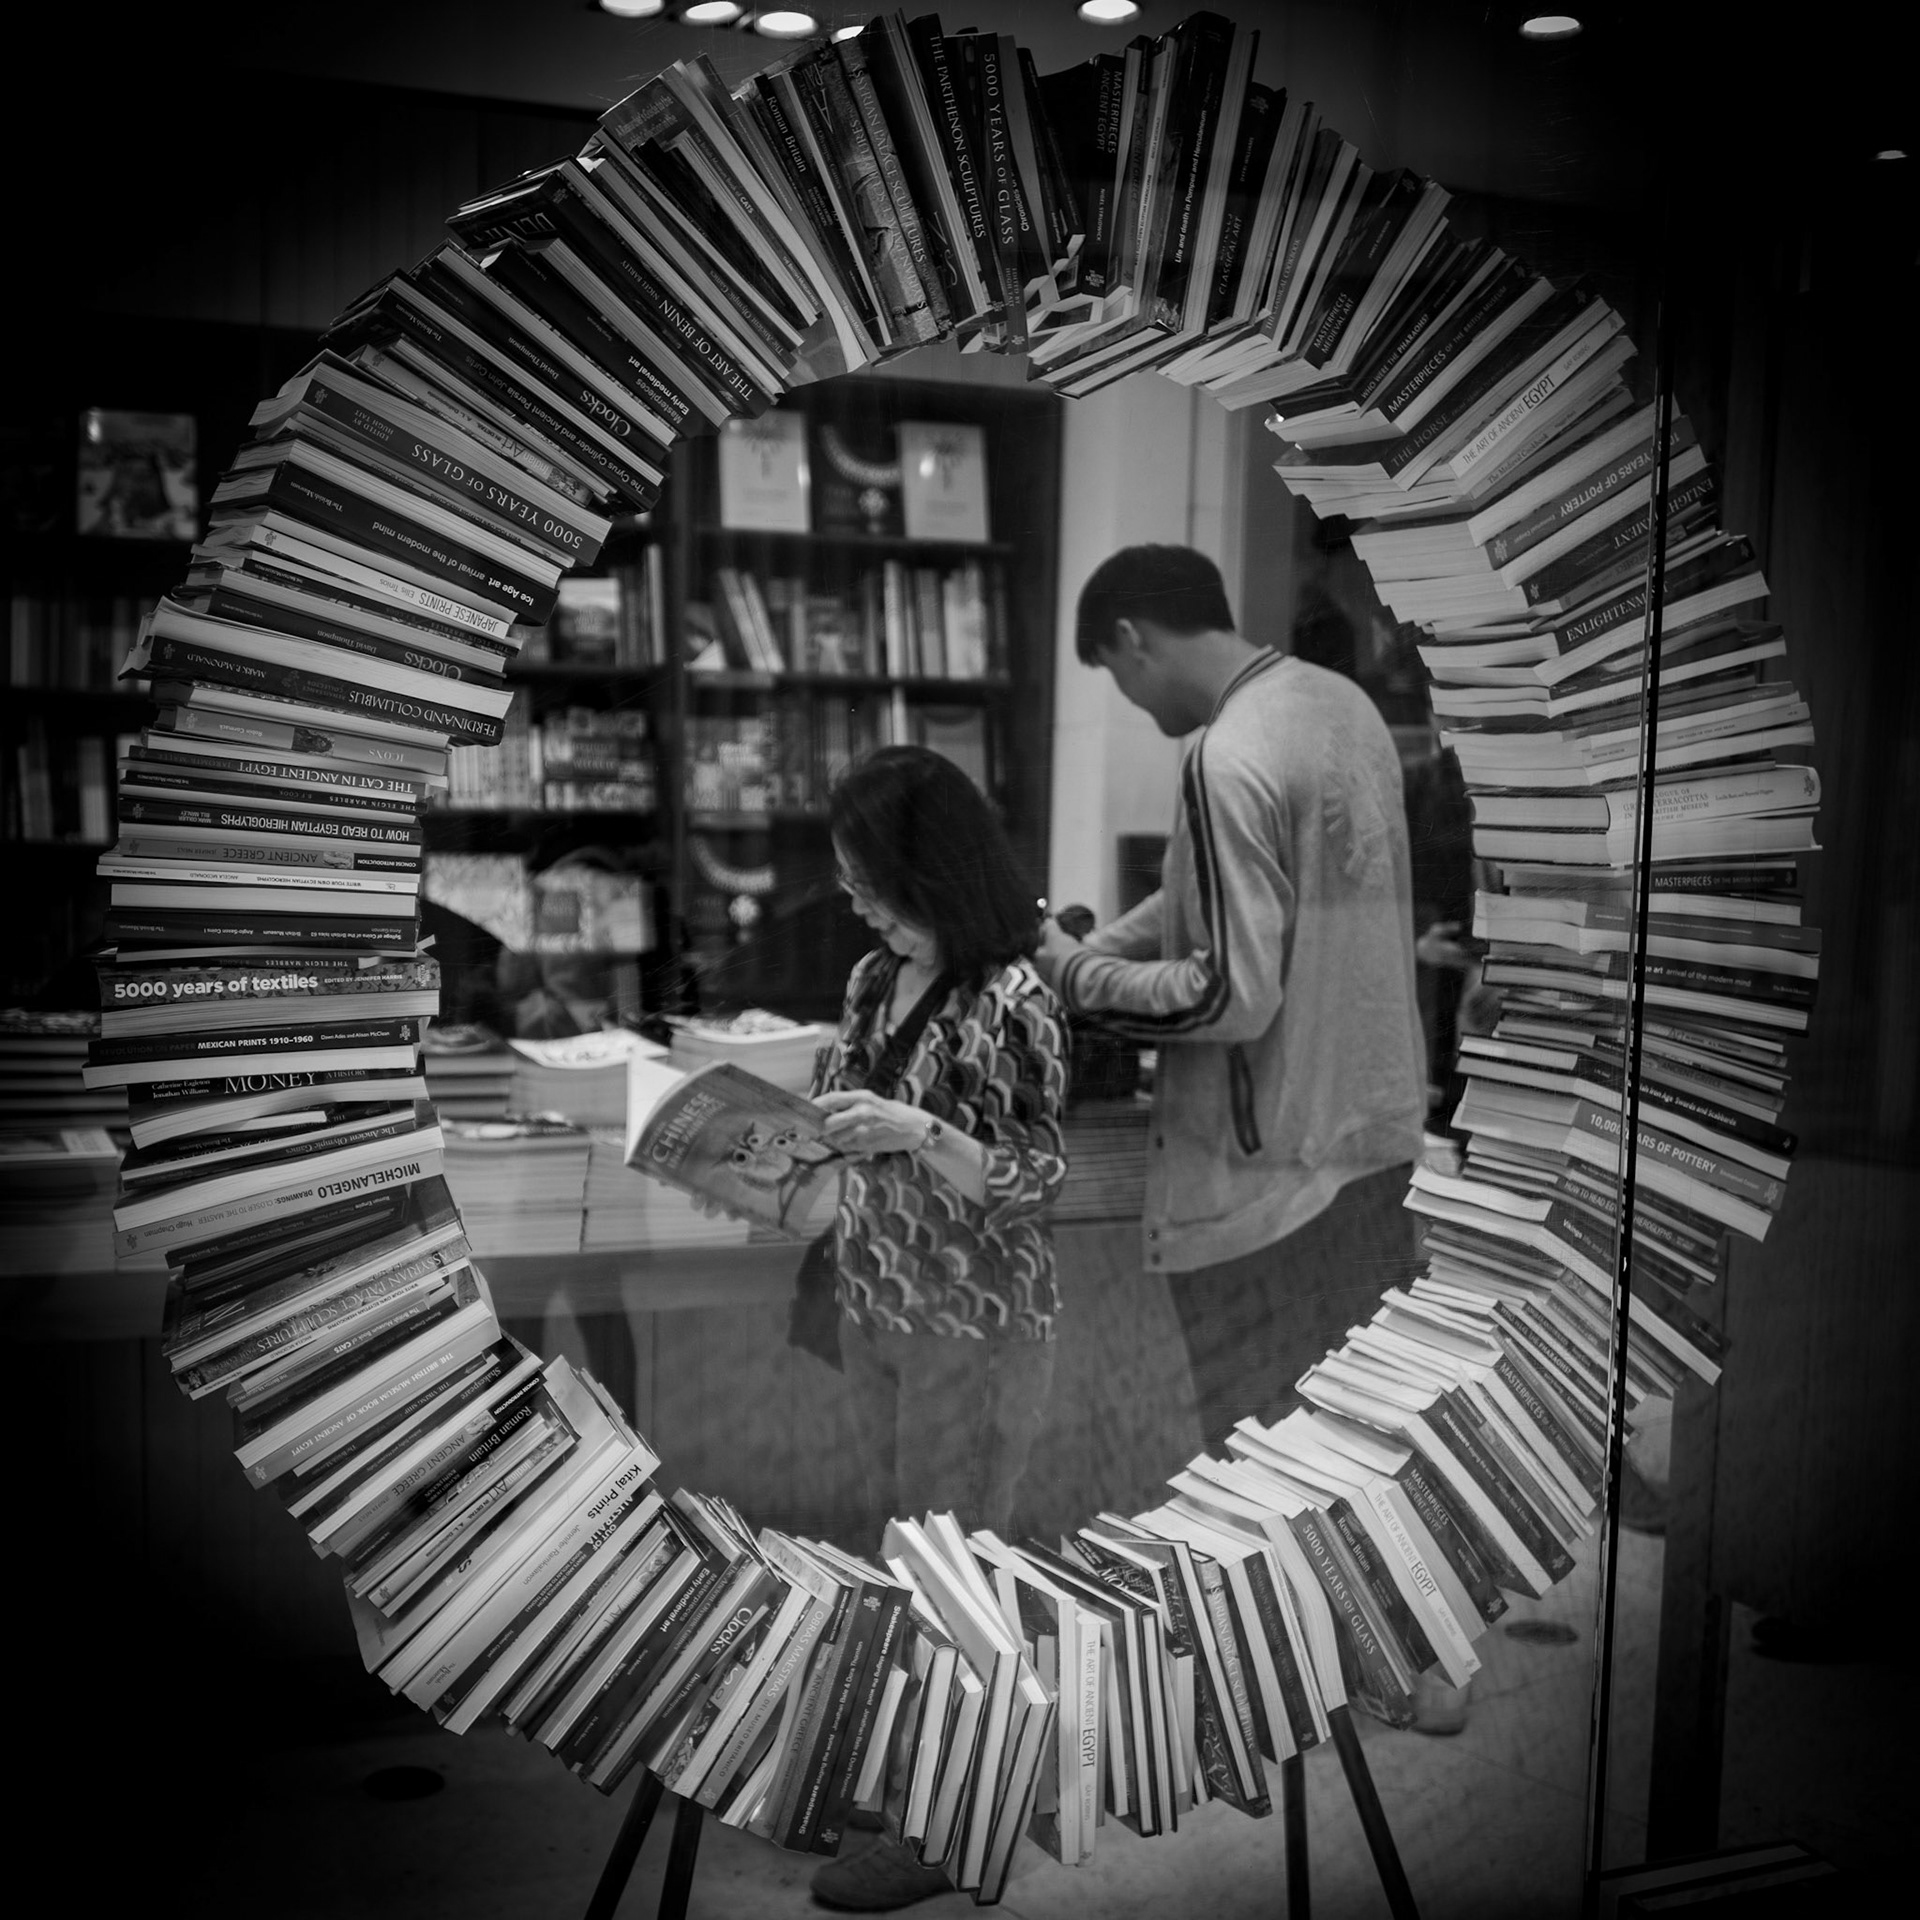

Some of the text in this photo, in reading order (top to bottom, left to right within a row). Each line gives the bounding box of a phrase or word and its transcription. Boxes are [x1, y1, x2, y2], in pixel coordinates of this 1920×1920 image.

[765, 95, 809, 173] Roman Britain
[928, 34, 987, 239] THE PARTHENON SCULPTURES
[1094, 68, 1111, 151] ANCIENT EGYPT
[1105, 70, 1124, 154] MASTERPIECES
[848, 60, 928, 264] ASSYRIAN PALACE SCULPTURES
[982, 52, 1014, 245] 5000 YEARS OF GLASS
[738, 195, 755, 214] CATS
[1174, 108, 1208, 263] Life and death in Pompeii and Herculaneum
[1216, 215, 1243, 296] CLASSICAL ART
[657, 297, 697, 339] BENIN
[691, 333, 714, 356] OF
[1312, 290, 1349, 349] MASTERPIECES
[1319, 296, 1356, 355] MEDIEVAL ART
[706, 349, 734, 378] ART
[1359, 311, 1431, 399] WHO WERE THE PHARAOHS?
[1385, 348, 1449, 414] MASTERPIECES
[574, 387, 634, 440] Clocks
[626, 354, 691, 415] Early medieval art
[633, 374, 684, 426] Masterpieces
[726, 370, 756, 401] THE
[462, 354, 647, 495] The Cyrus Cylinder and Ancient Persia John Curtis
[1461, 373, 1558, 465] THE ART OF ANCIENT EGYPT
[409, 441, 583, 550] 5000 YEARS OF GLASS
[1555, 450, 1651, 518] YEARS OF POTTERY
[1609, 476, 1716, 550] ENLIGHMENT
[370, 520, 535, 606] Ice Age art arrival of the modern mind
[377, 577, 499, 633] JAPANESE PRINTS Ellis Tinios
[1563, 579, 1672, 643] ENLIGHTENMT
[315, 627, 464, 682] Clocks David Thompson
[347, 688, 497, 737] FERDINAND COLUMBUS
[218, 722, 404, 762] ICONS Robin Cormack
[236, 760, 413, 793] THE CAT IN ANCIENT EGYPT
[219, 812, 409, 841] HOW TO READ EGYPTIAN HIEROGLYPHS
[222, 846, 416, 868] CONCISE INTRODUCTION ANCIENT GREECE
[1654, 875, 1712, 887] MASTERPIECES
[113, 981, 167, 999] 5000
[171, 981, 224, 998] years
[227, 976, 248, 992] of
[251, 972, 318, 991] textiles
[197, 1039, 236, 1050] MEXICAN
[237, 1037, 267, 1047] PRINTS
[151, 1078, 211, 1091] Catherine Eagleton
[152, 1086, 209, 1099] Jonathan Williams
[222, 1067, 316, 1094] MONEY
[652, 1091, 712, 1164] CHINESE
[1621, 1126, 1657, 1150] ARS
[1655, 1140, 1672, 1156] OF
[1670, 1146, 1717, 1174] POTTERY
[315, 1161, 421, 1199] MICHELANGELO
[1559, 1218, 1584, 1240] Vikings
[332, 1339, 352, 1355] CATS
[289, 1350, 454, 1457] THE BRITISH MUSEUM BOOK OF ANCIENT EGYPT
[458, 1364, 502, 1402] Shakespeare
[1496, 1362, 1546, 1420] MASTERPIECES
[467, 1404, 532, 1464] Roman Britain
[585, 1460, 642, 1523] Kitaj Prints
[1406, 1468, 1452, 1526] MASTERPIECES
[1300, 1523, 1378, 1656] 5000 YEARS OF GLASS
[708, 1603, 754, 1658] Clocks
[764, 1608, 826, 1700] OBRAS MAESTRAS
[878, 1604, 902, 1656] Shakespeare
[1080, 1640, 1096, 1768] THE ART OF ANCIENT EGYPT
[797, 1783, 822, 1836] Shakespeare
